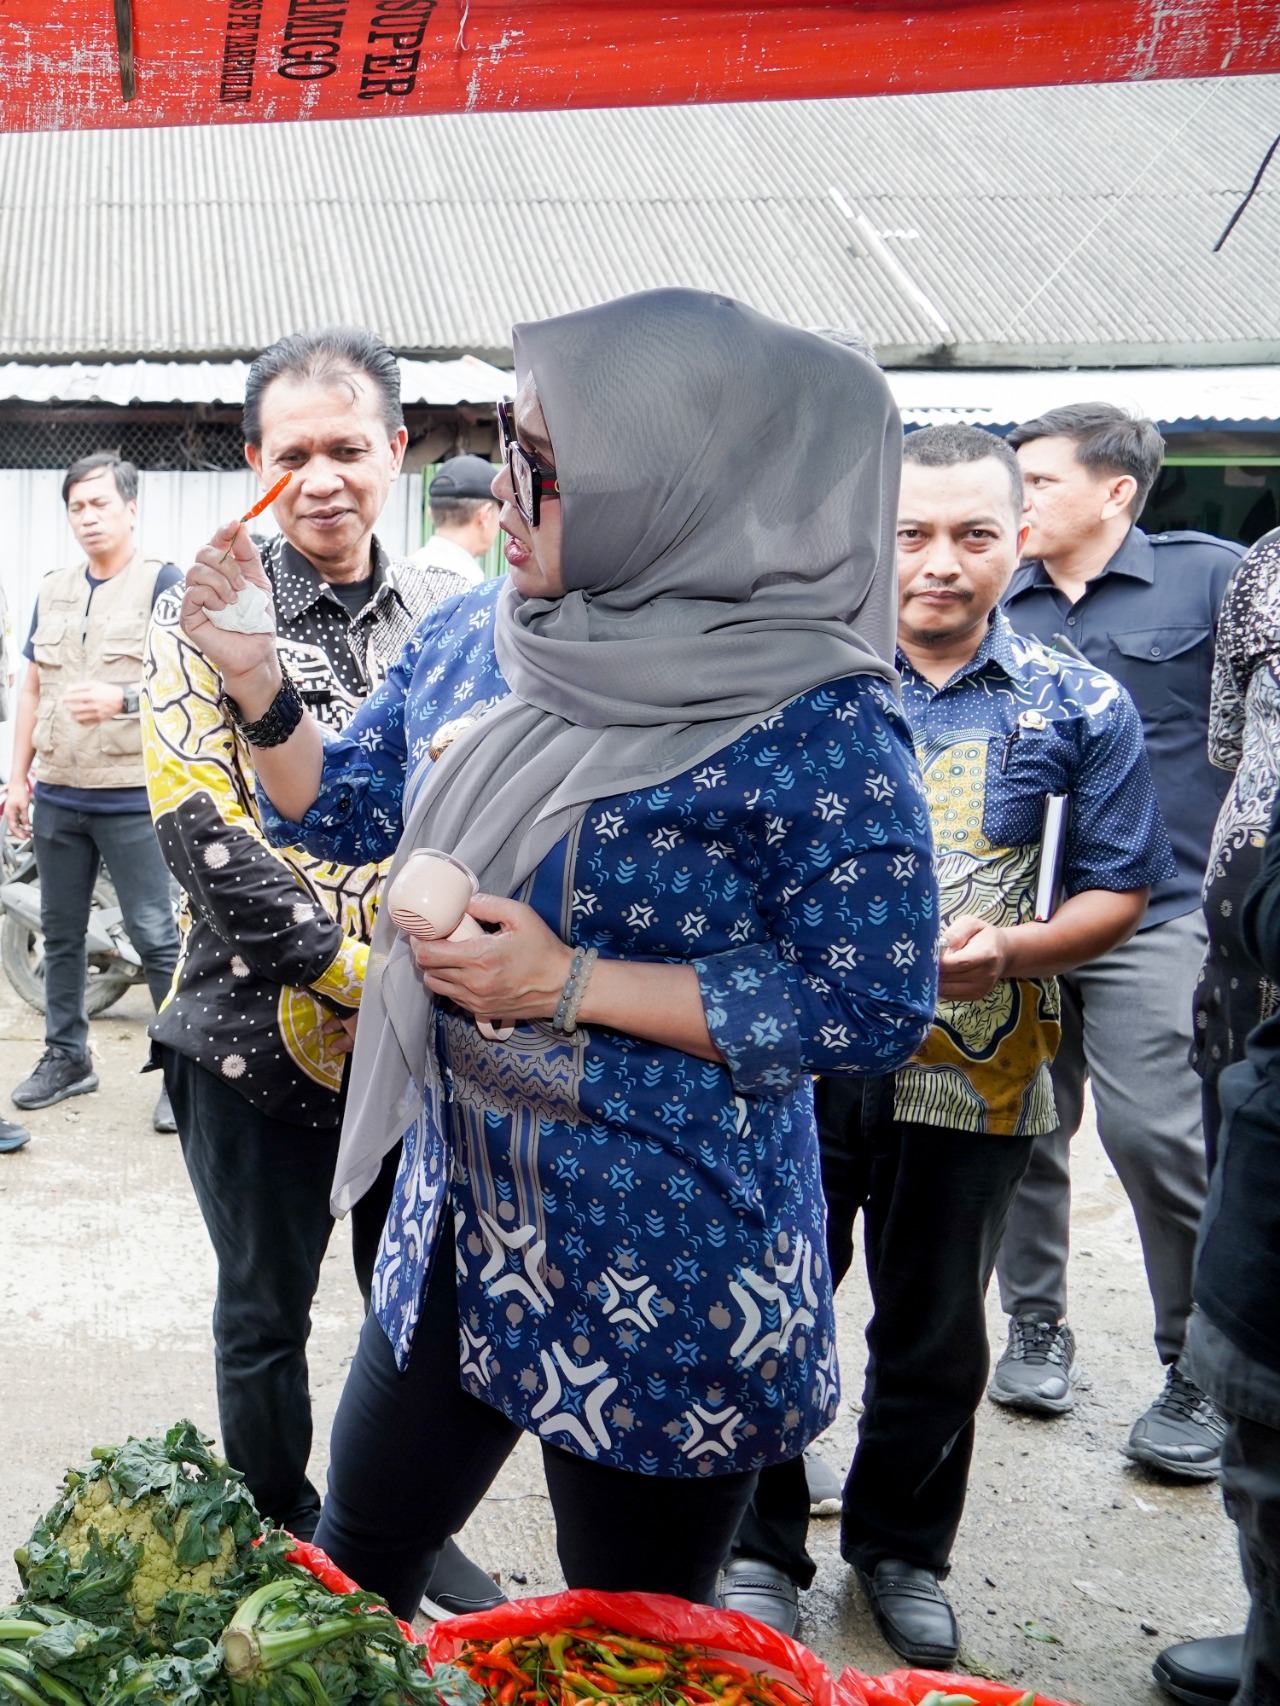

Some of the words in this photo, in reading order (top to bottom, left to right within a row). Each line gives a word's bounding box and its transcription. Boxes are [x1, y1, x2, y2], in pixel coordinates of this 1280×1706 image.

[227, 13, 261, 30] PE
[357, 0, 438, 99] SUPER
[219, 33, 259, 103] TARPAULIN
